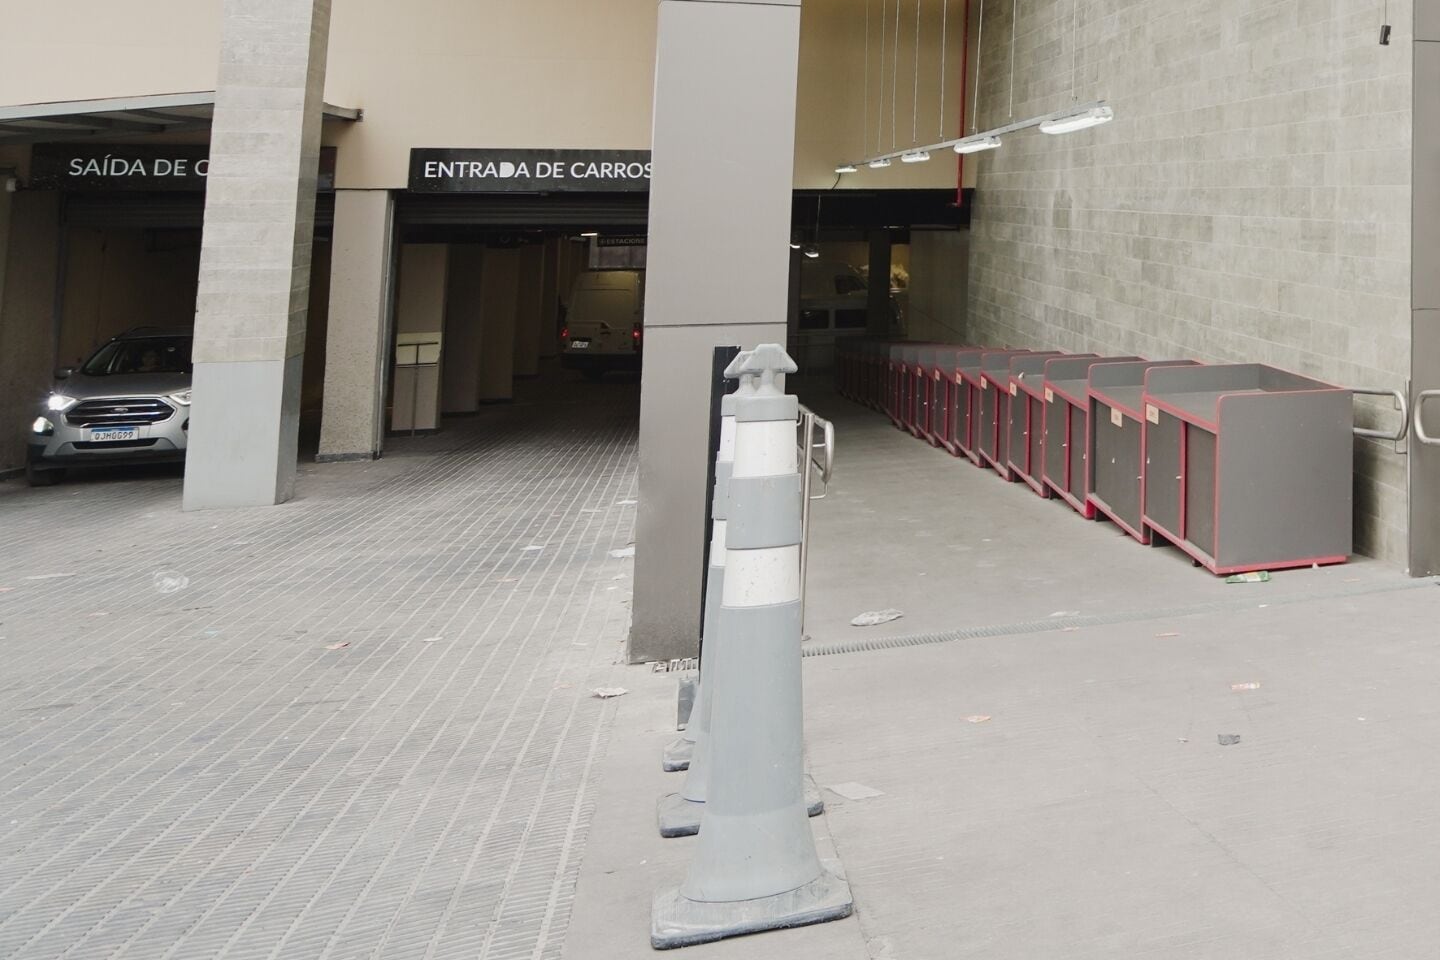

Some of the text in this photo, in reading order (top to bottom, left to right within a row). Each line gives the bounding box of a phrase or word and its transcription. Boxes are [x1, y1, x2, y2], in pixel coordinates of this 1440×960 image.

[68, 154, 147, 177] SAÍDA
[153, 159, 188, 177] DE
[424, 161, 651, 179] ENTRADA DE CARROS
